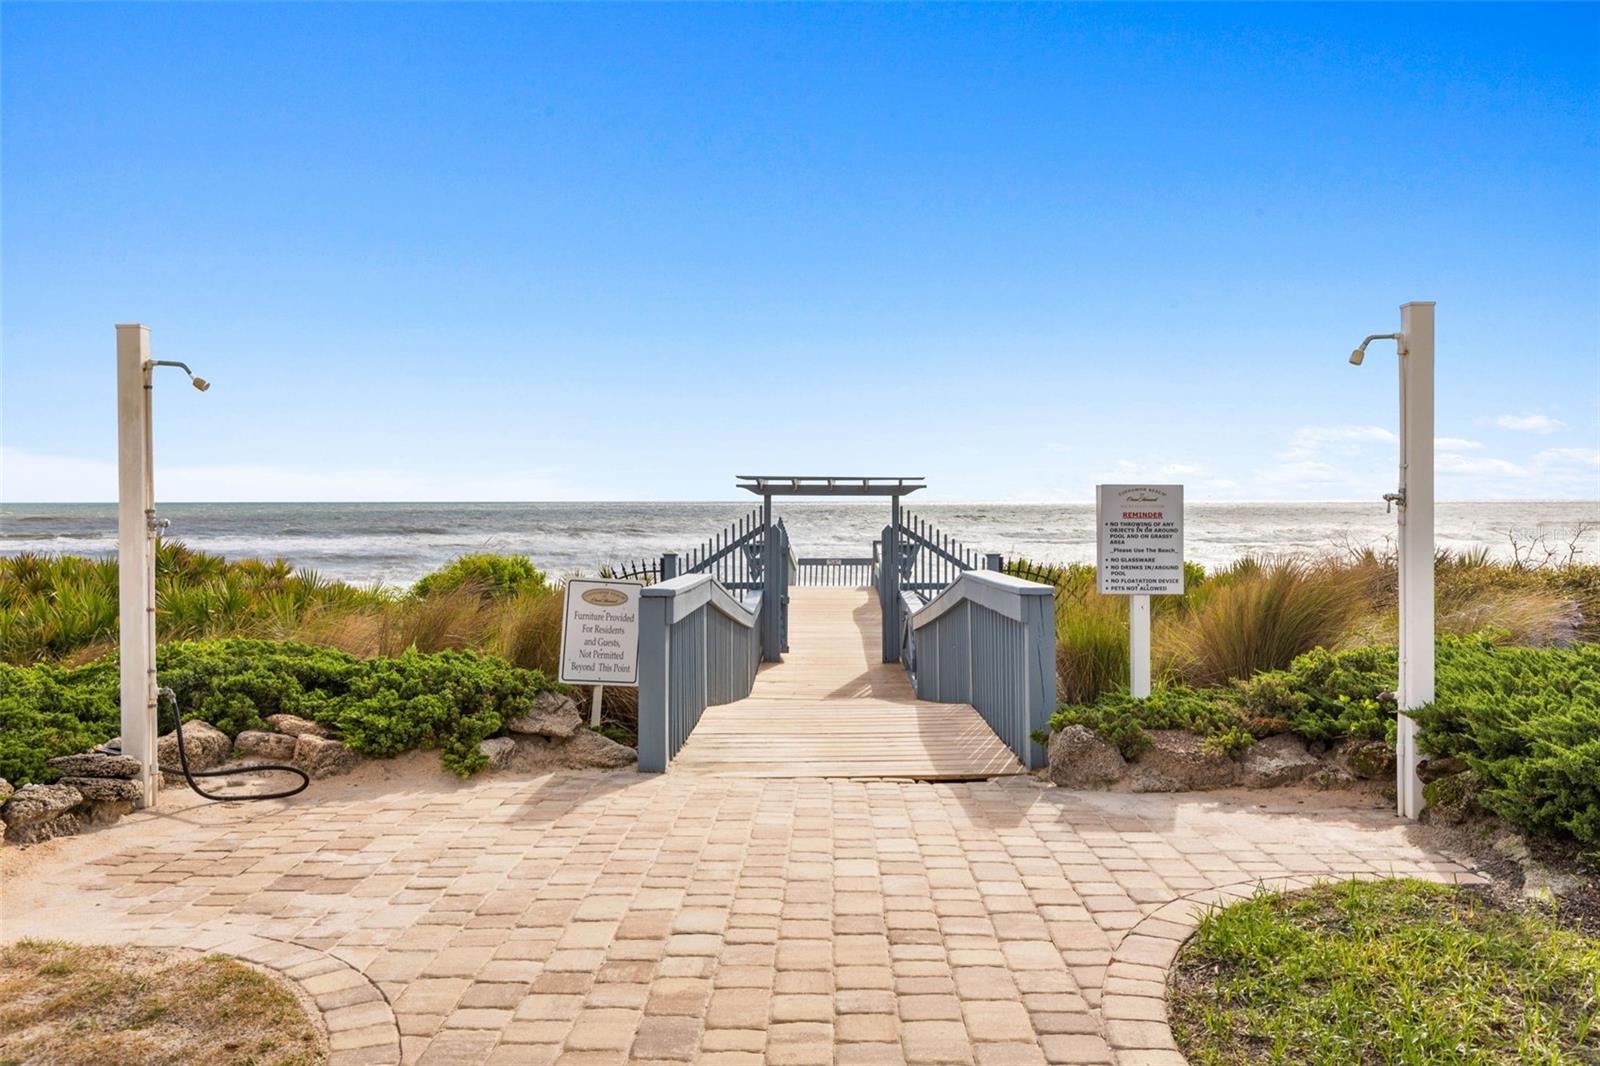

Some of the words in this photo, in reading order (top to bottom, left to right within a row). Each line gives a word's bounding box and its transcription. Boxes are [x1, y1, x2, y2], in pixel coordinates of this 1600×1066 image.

[574, 611, 604, 620] Furniture
[606, 613, 635, 622] Provided
[582, 625, 592, 633] For
[595, 626, 625, 634] Residents
[584, 638, 596, 646] and
[597, 638, 620, 648] Guests,
[579, 650, 591, 658] Not
[593, 651, 624, 659] Permitted
[571, 662, 595, 673] Beyond
[599, 663, 612, 671] This
[614, 664, 630, 672] Point
